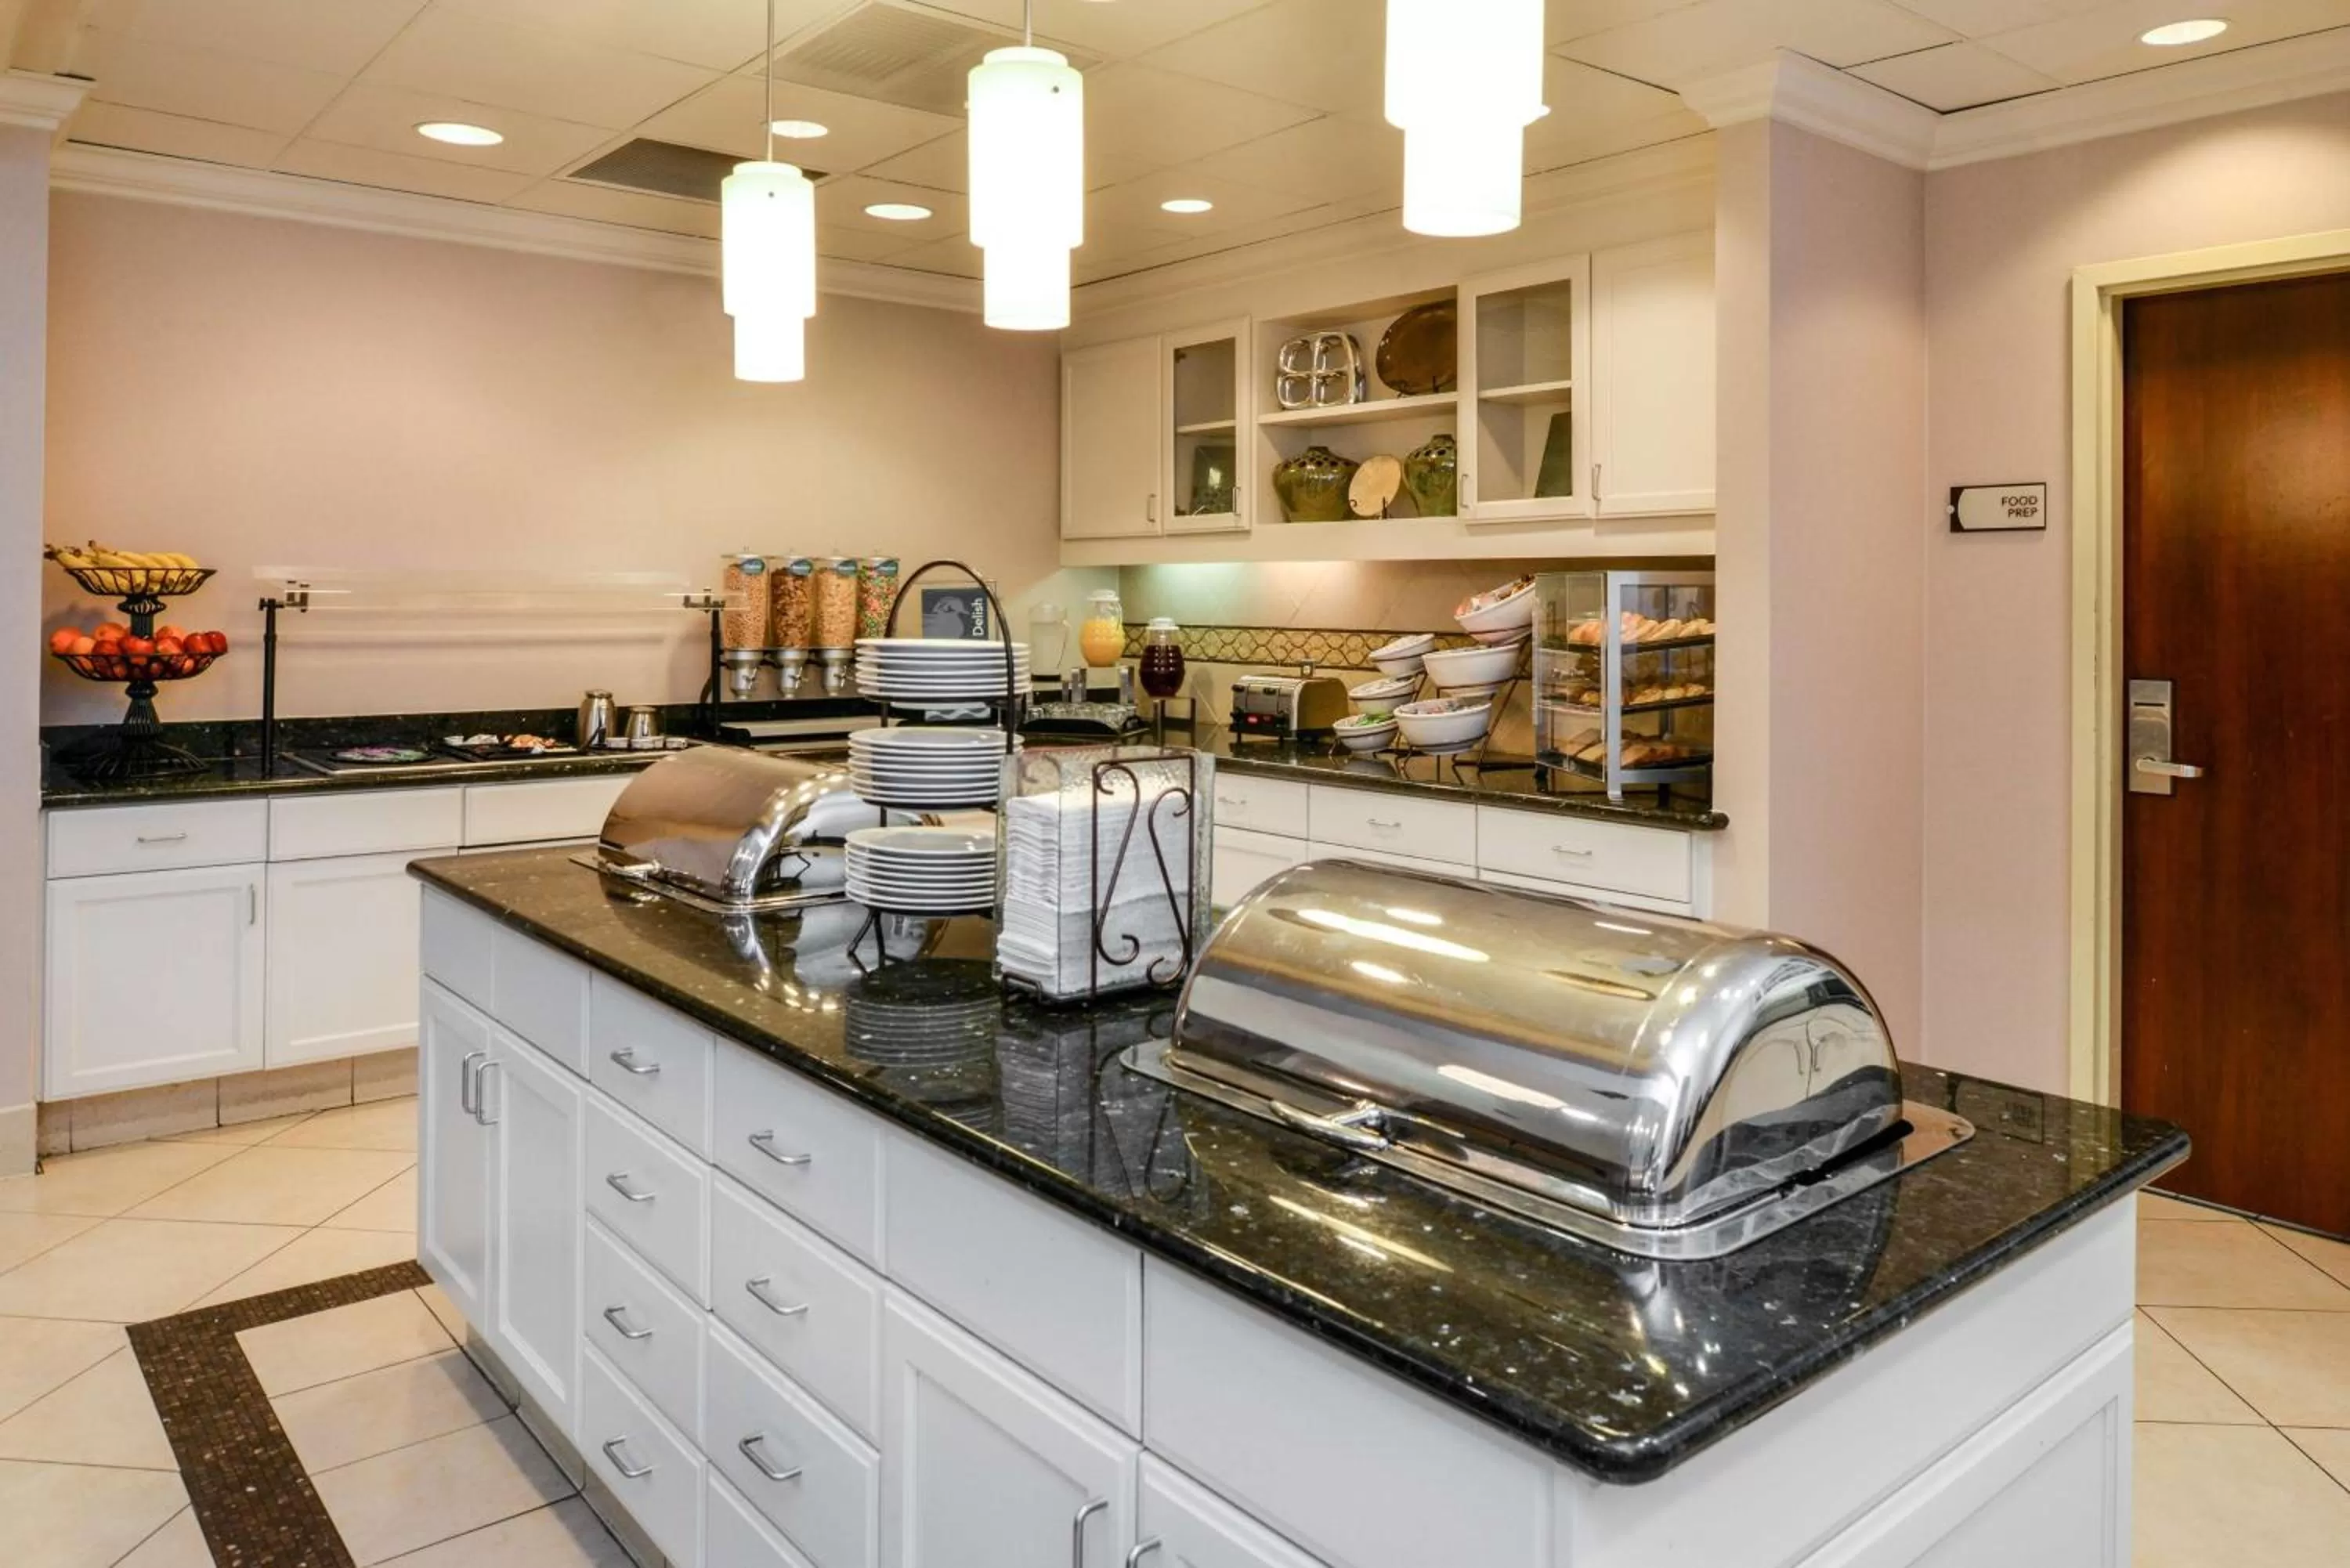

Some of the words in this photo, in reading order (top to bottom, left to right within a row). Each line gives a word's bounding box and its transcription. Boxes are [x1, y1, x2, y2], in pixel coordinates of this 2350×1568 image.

[2001, 496, 2038, 507] FOOD
[2008, 508, 2038, 518] PREP
[971, 598, 984, 636] Delish
